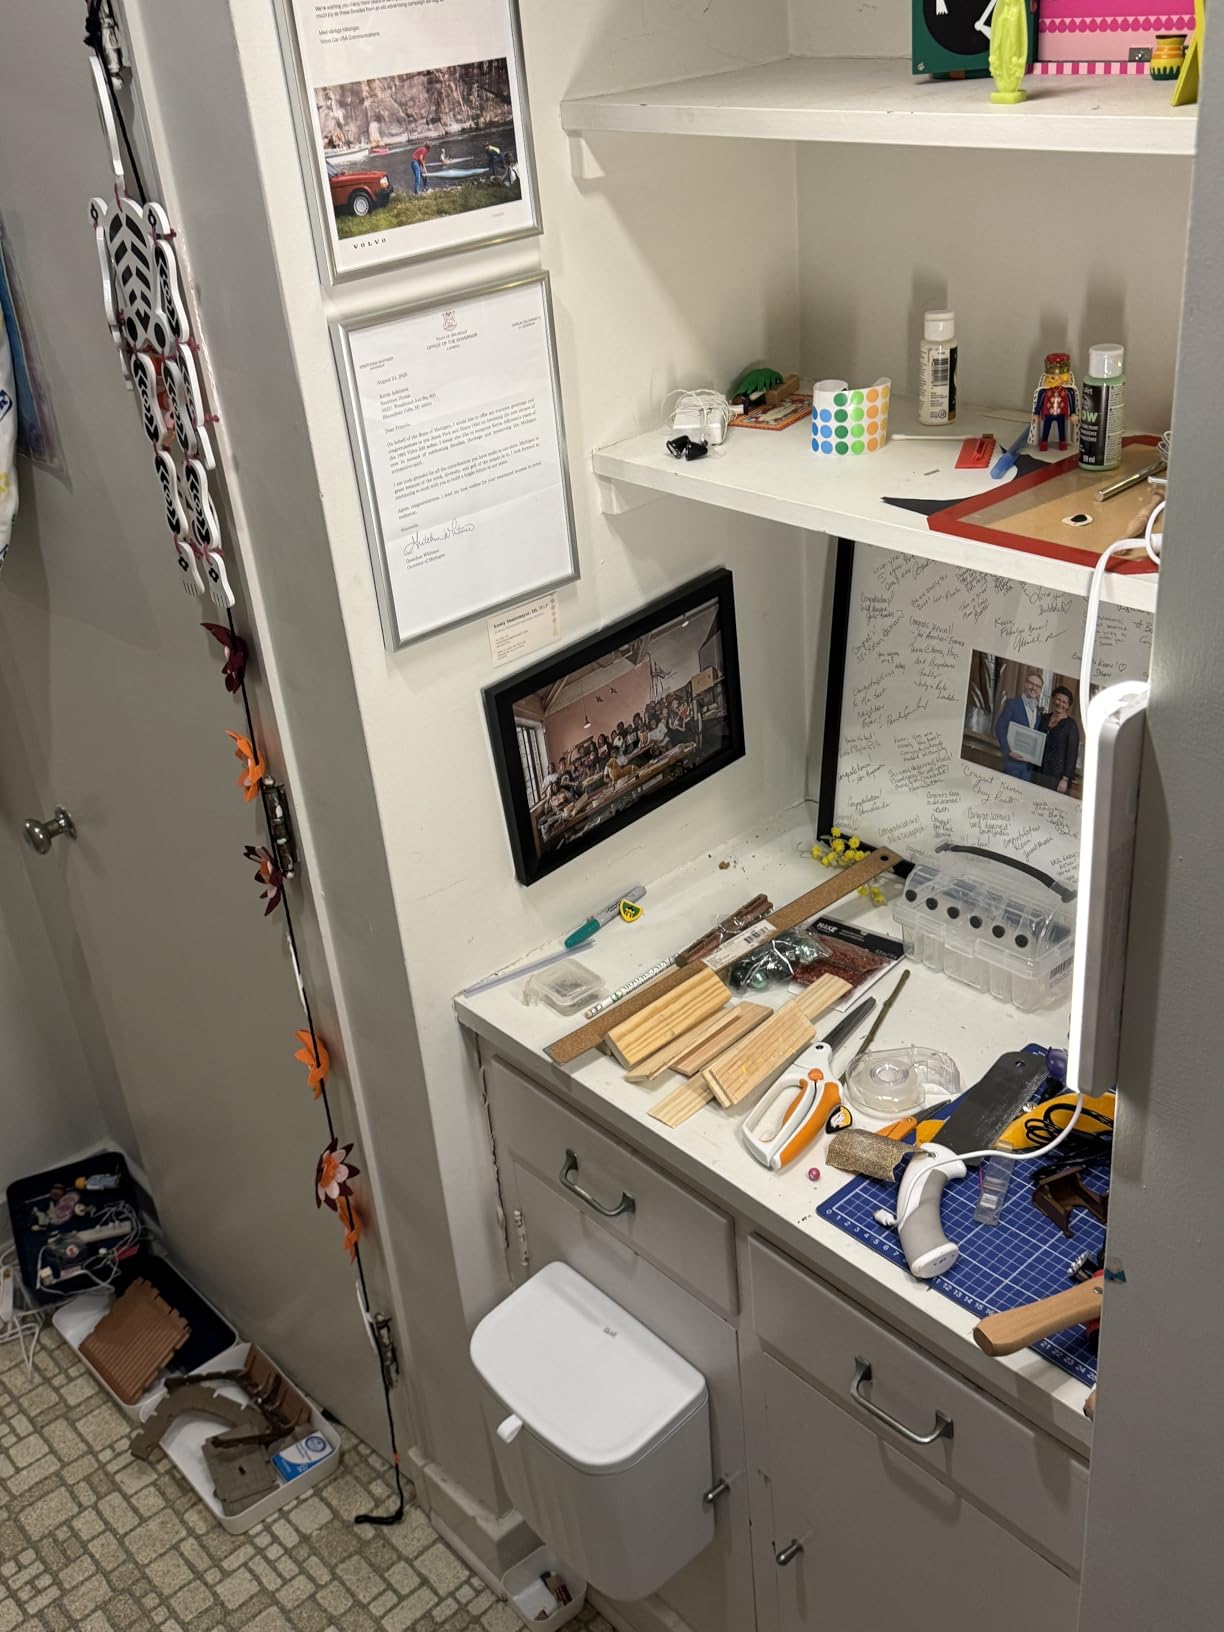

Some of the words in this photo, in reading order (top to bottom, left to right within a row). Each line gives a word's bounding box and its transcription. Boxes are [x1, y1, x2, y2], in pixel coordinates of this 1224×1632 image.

[353, 238, 387, 250] VOLVO
[942, 1282, 952, 1292] 12
[953, 1288, 963, 1298] 13
[964, 1296, 973, 1304] 14
[974, 1302, 984, 1310] 15
[1040, 1340, 1051, 1350] 21
[1051, 1348, 1064, 1357] 22
[1063, 1357, 1075, 1366] 23
[1075, 1365, 1087, 1374] 24
